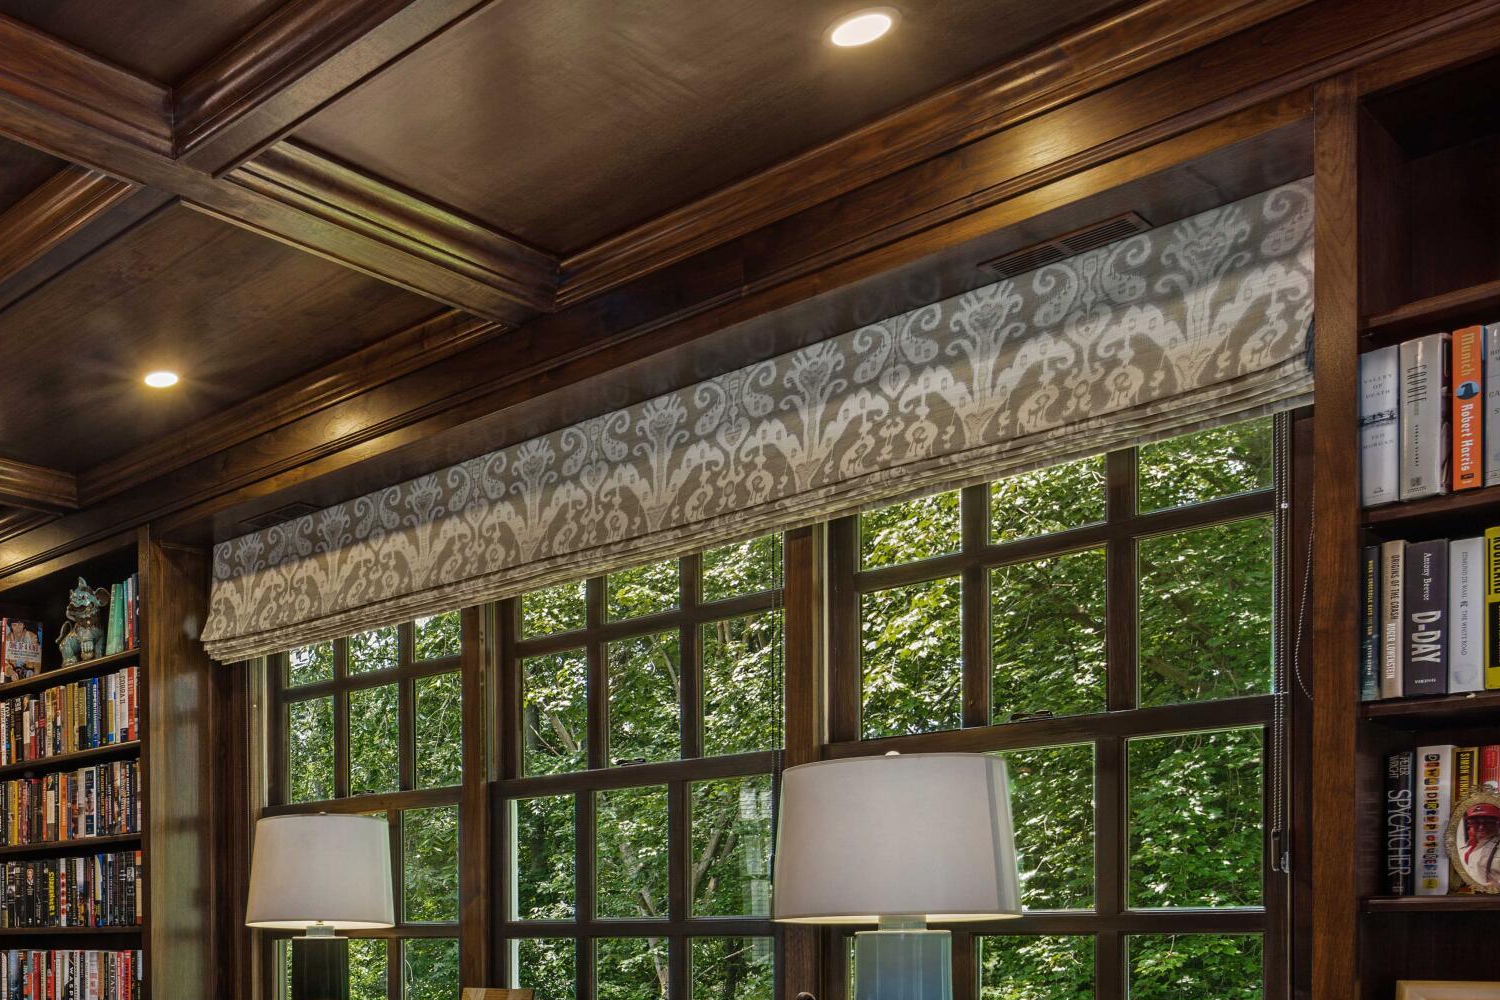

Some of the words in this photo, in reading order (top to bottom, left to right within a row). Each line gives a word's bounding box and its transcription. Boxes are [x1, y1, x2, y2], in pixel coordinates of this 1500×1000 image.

[1461, 333, 1476, 377] Munich
[1372, 383, 1383, 391] OF
[1461, 403, 1475, 438] Robert
[1461, 440, 1474, 471] Harris
[1390, 555, 1400, 578] ORIGINS
[1422, 552, 1433, 576] Antony
[1390, 579, 1400, 587] OF
[1390, 588, 1400, 600] THE
[1422, 577, 1432, 601] Beevor
[1390, 600, 1400, 620] CRASH
[1386, 623, 1397, 642] ROGER
[1411, 610, 1441, 663] D-DAY
[1386, 642, 1397, 679] LOWENSTEIN
[1460, 753, 1470, 774] SIMON
[1387, 789, 1412, 877] SPYCATCHER
